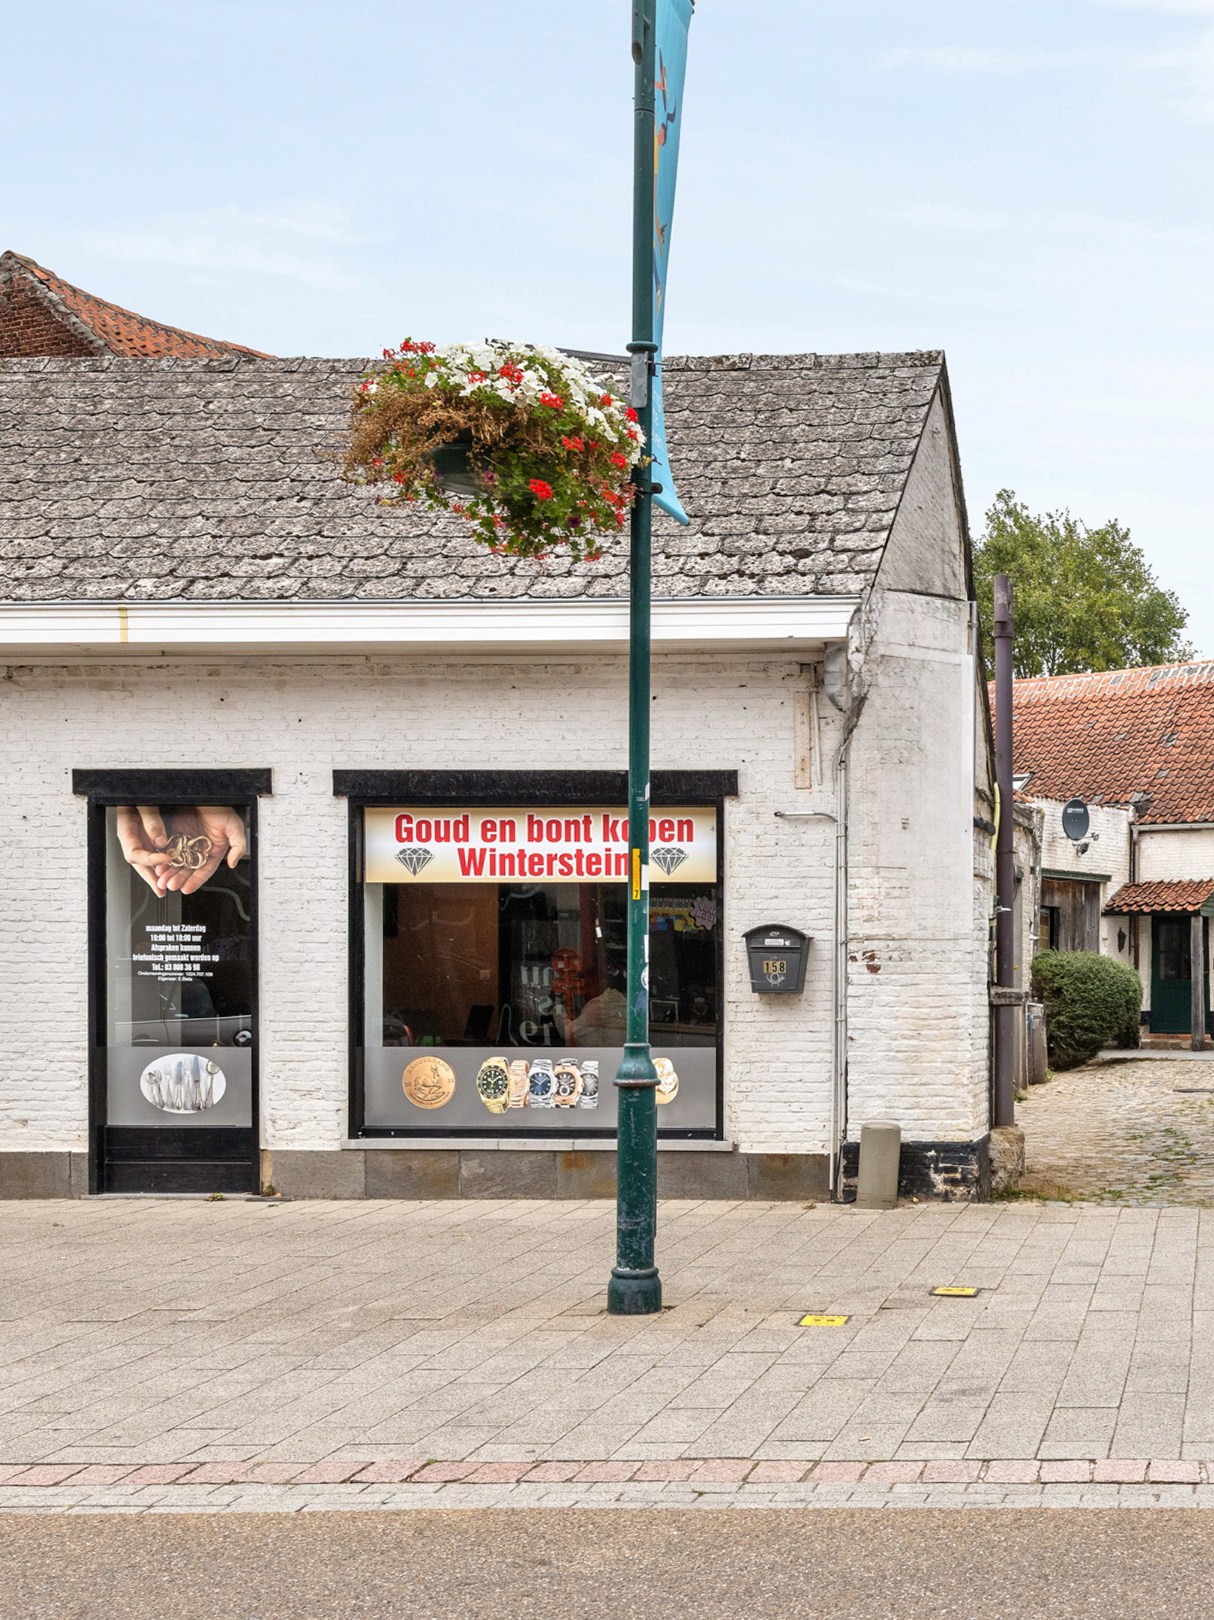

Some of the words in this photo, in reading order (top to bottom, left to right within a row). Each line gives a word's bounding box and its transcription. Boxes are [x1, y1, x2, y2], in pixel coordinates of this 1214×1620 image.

[394, 813, 469, 843] Goud
[480, 818, 516, 843] en
[527, 813, 592, 843] bont
[457, 847, 629, 877] Winterstein
[145, 924, 172, 933] maandag
[172, 924, 180, 932] tot
[181, 924, 206, 933] Zaterdag
[166, 934, 175, 942] tot
[212, 954, 219, 962] op
[765, 961, 785, 973] 158
